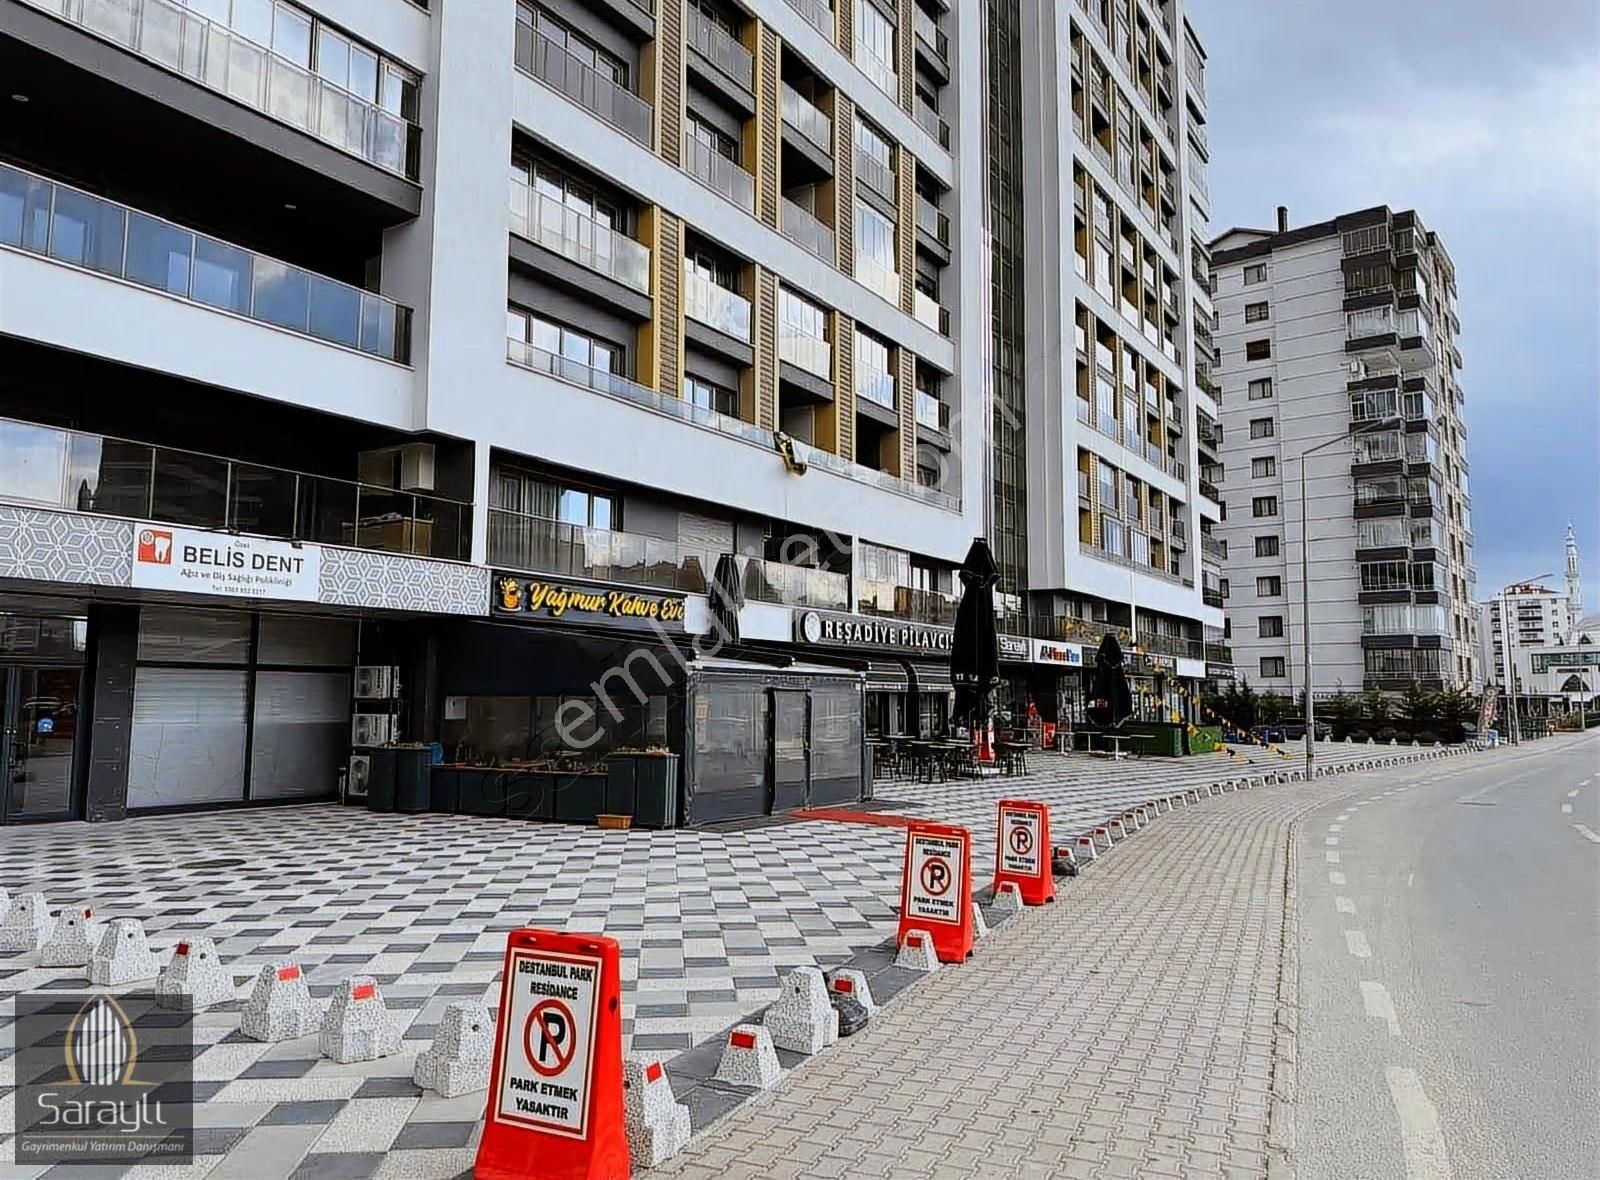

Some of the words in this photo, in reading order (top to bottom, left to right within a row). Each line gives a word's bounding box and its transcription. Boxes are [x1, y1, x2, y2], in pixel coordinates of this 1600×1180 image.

[183, 546, 245, 568] BELİS
[251, 553, 304, 573] DENT
[529, 582, 607, 616] Yağmur
[609, 591, 658, 617] Kahve
[661, 598, 684, 621] Evi
[825, 620, 896, 645] REŞADİYE
[519, 960, 569, 980] DESTANBUL
[569, 967, 593, 983] PARK
[530, 980, 579, 1000] RESİDANCE
[510, 1077, 539, 1094] PARK
[540, 1083, 579, 1102] ETMEK
[515, 1097, 569, 1120] YASAKTIR
